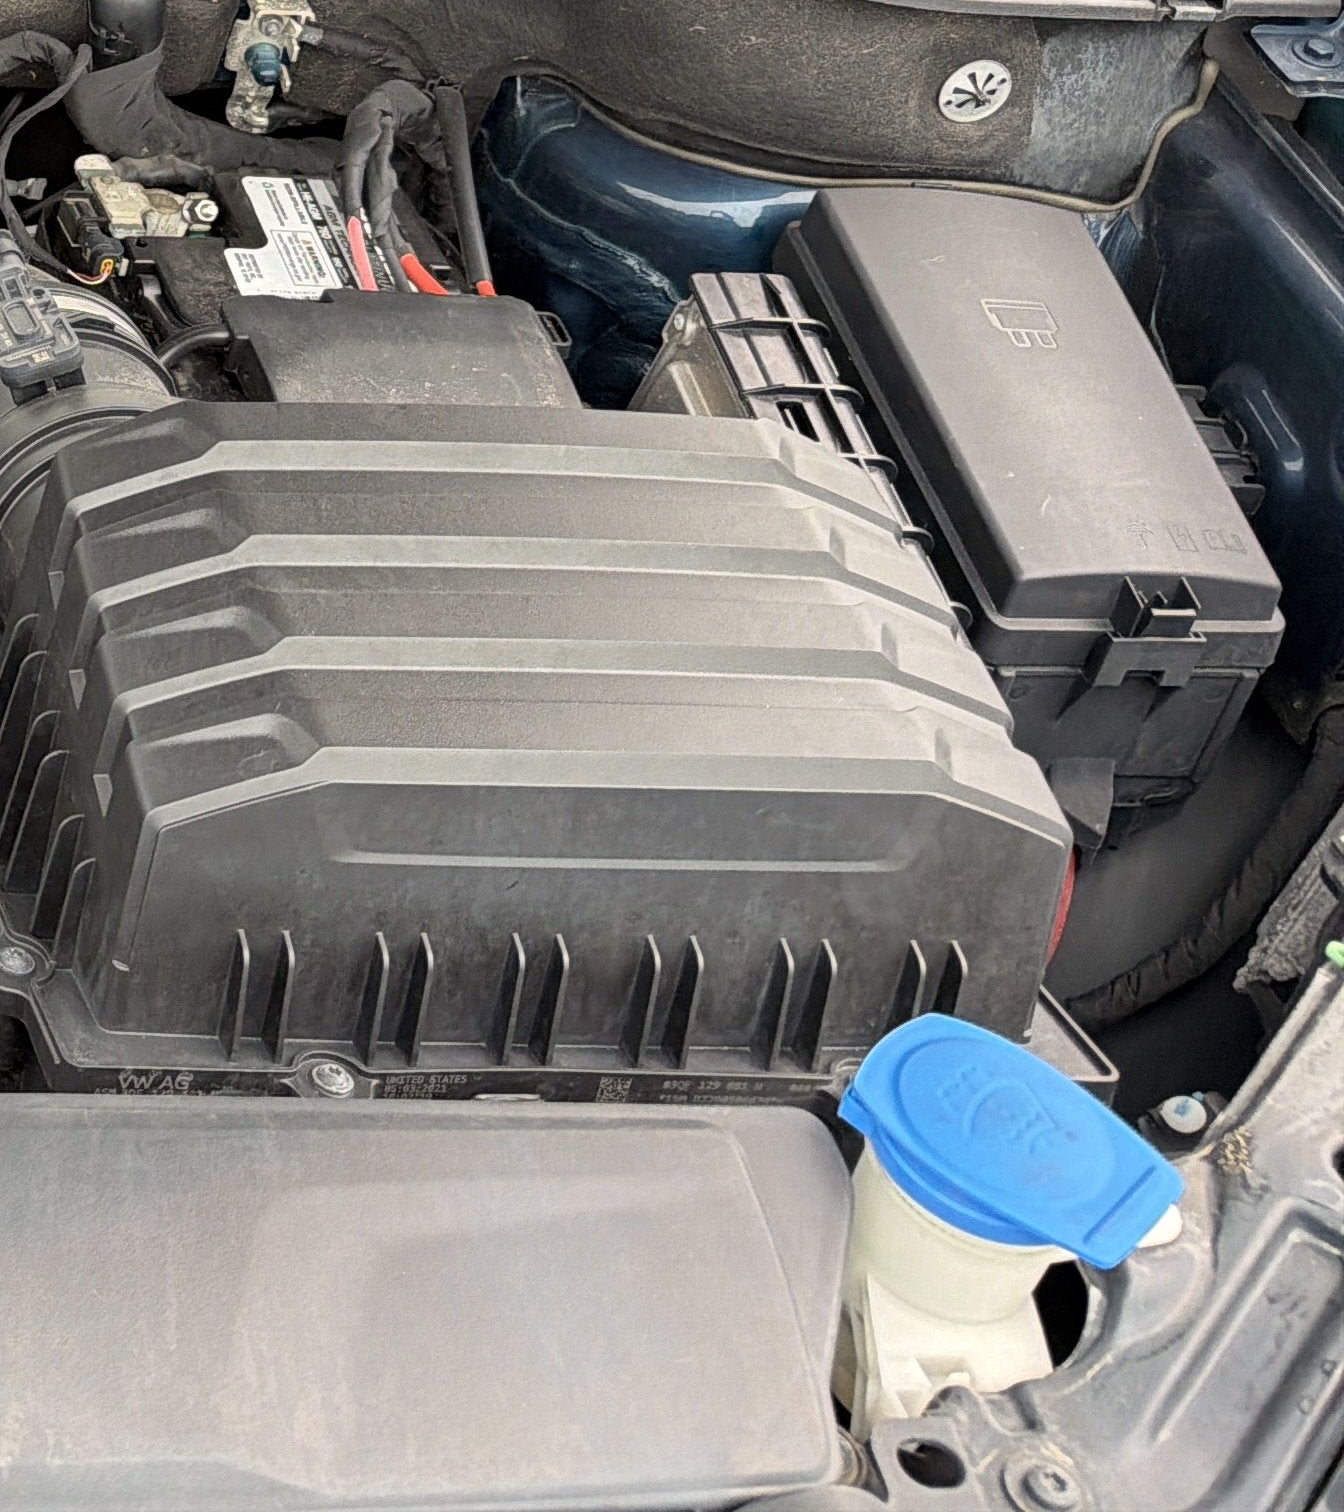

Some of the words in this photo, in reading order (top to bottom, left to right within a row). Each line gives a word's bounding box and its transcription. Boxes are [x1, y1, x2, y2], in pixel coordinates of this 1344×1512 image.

[118, 1071, 156, 1089] VW
[160, 1072, 194, 1090] AG
[385, 1075, 424, 1084] UNITED
[430, 1074, 468, 1084] STATES
